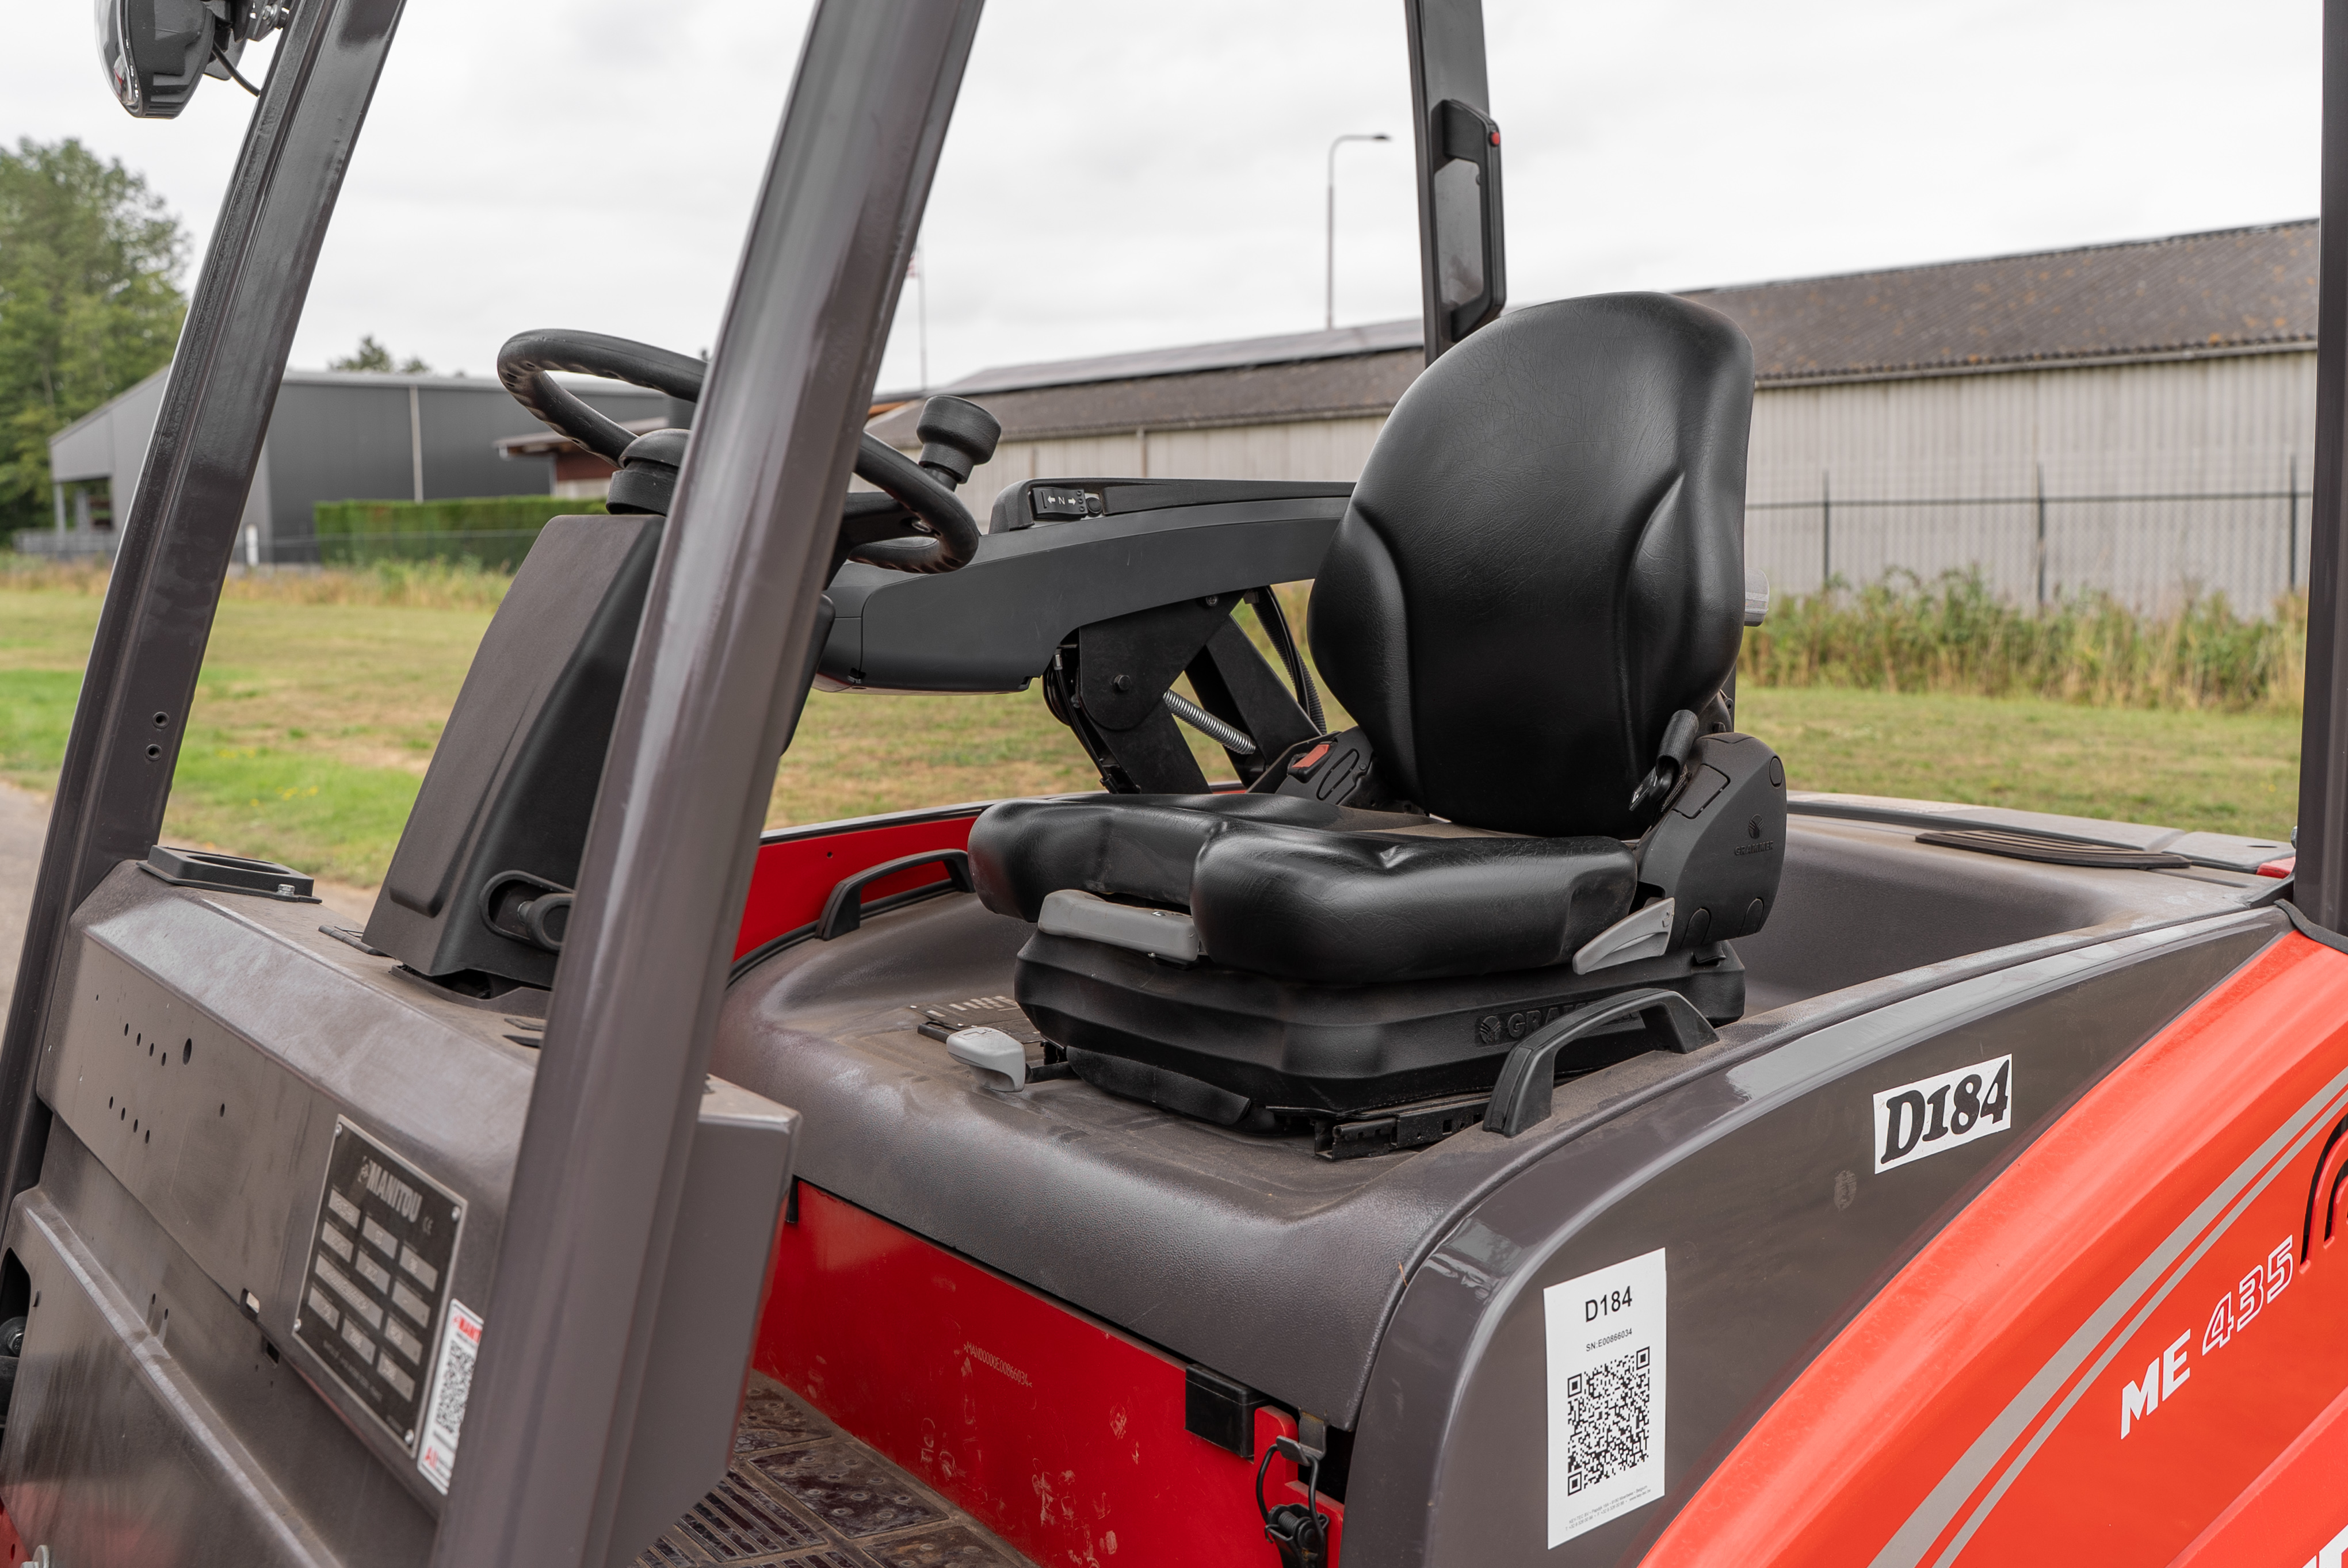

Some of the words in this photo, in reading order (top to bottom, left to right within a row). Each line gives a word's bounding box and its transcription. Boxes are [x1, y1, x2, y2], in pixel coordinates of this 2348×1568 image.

[1058, 496, 1066, 506] N
[1734, 840, 1774, 856] GRAMMER
[1881, 1059, 2010, 1164] D184
[366, 1159, 423, 1223] MANITOU
[1585, 1286, 1633, 1322] D184
[1586, 1328, 1633, 1352] SN:E00866034
[2120, 1328, 2191, 1440] ME
[2201, 1234, 2293, 1356] 435
